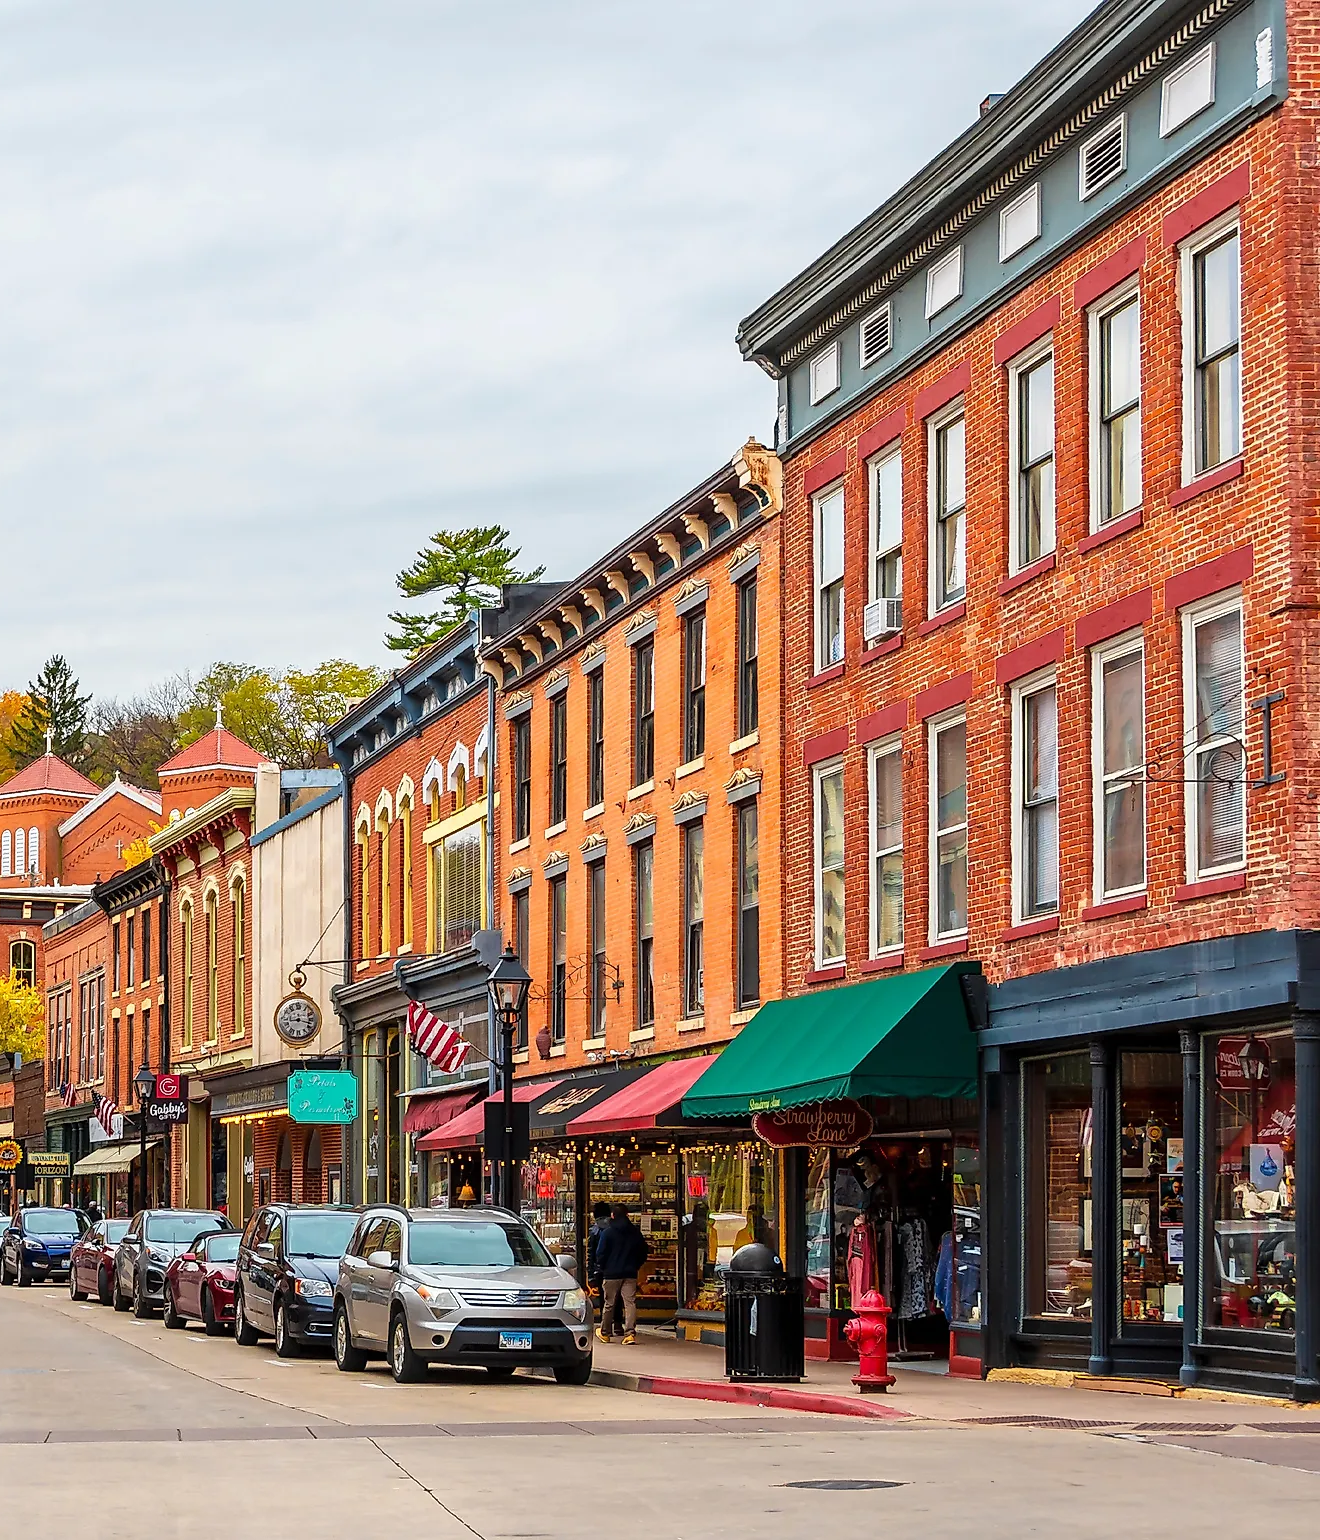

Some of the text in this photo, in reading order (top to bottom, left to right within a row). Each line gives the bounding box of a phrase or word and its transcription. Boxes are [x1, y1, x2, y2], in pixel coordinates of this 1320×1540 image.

[160, 1078, 177, 1096] G
[307, 1074, 336, 1087] Petals
[150, 1102, 187, 1119] Gabby's
[773, 1105, 856, 1134] Strawberry
[807, 1122, 848, 1142] Lane
